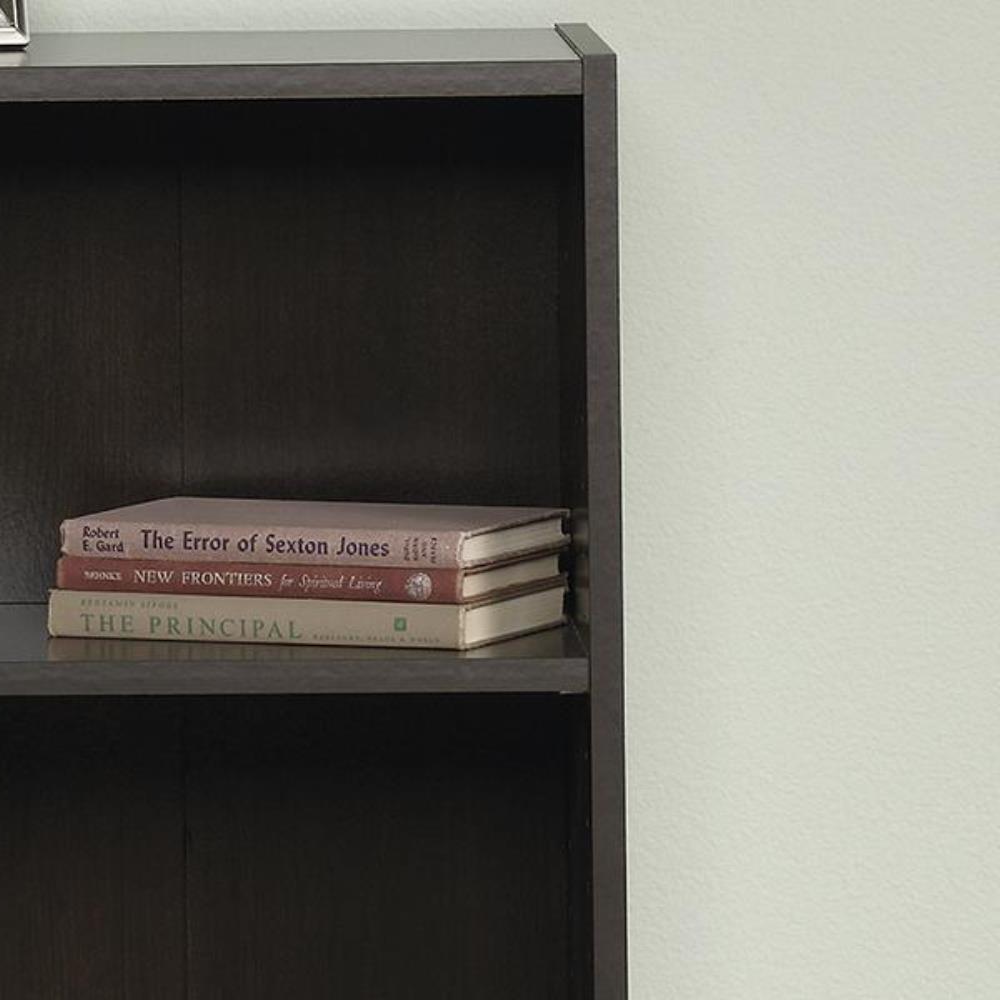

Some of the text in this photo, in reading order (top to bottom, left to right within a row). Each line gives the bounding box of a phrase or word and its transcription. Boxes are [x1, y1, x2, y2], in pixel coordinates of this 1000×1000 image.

[82, 526, 119, 539] Robert
[96, 541, 124, 553] Gard
[141, 529, 175, 550] The
[183, 531, 230, 551] Error
[237, 533, 258, 553] of
[265, 534, 329, 555] Sexton
[336, 536, 390, 557] Jones
[133, 569, 174, 584] NEW
[182, 571, 273, 587] FRONTIERS
[80, 613, 135, 633] THE
[150, 614, 303, 640] PRINCIPAL
